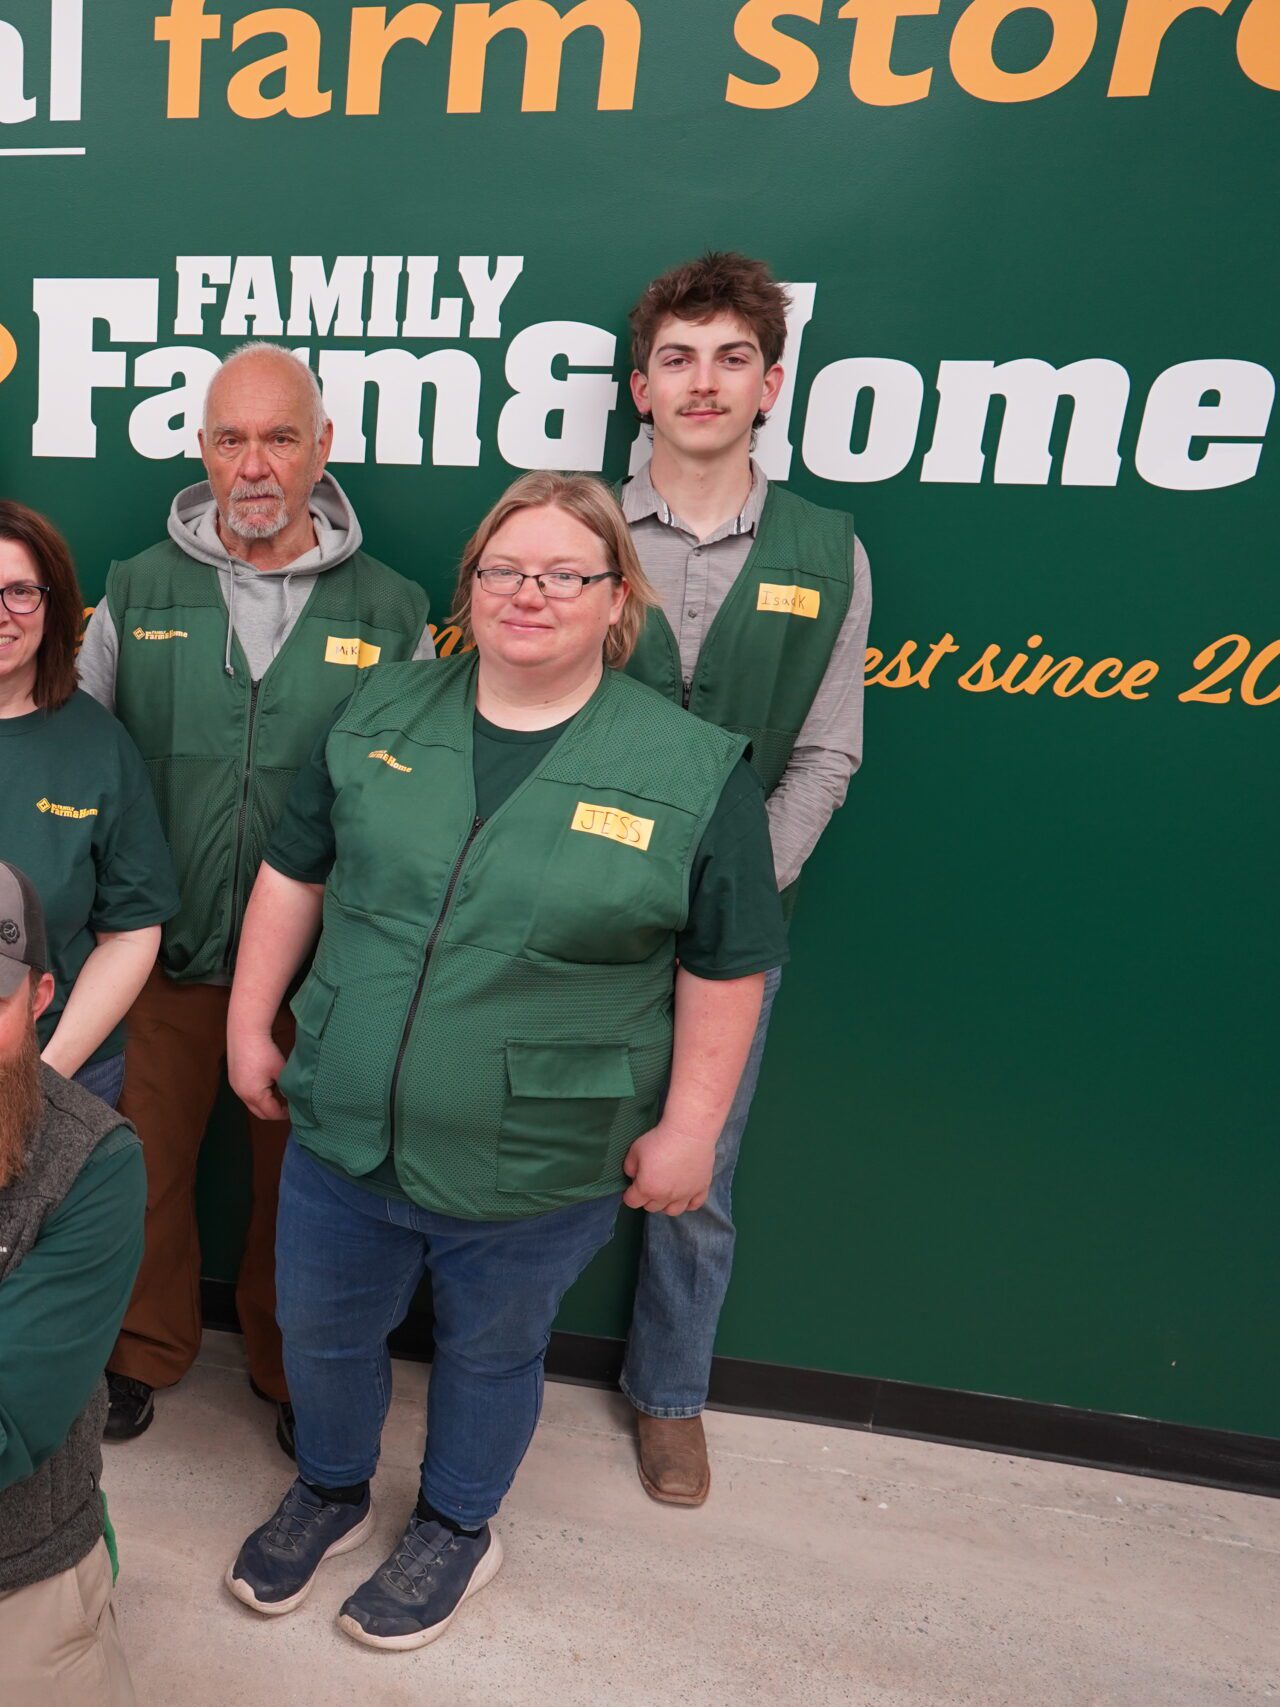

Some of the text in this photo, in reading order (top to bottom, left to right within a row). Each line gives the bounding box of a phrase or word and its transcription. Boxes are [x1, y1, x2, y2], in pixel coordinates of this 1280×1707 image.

[154, 0, 641, 119] farm
[174, 255, 524, 339] FAMILY
[31, 277, 1275, 491] Fam&ome
[957, 634, 1160, 701] since
[581, 809, 641, 843] JESS
